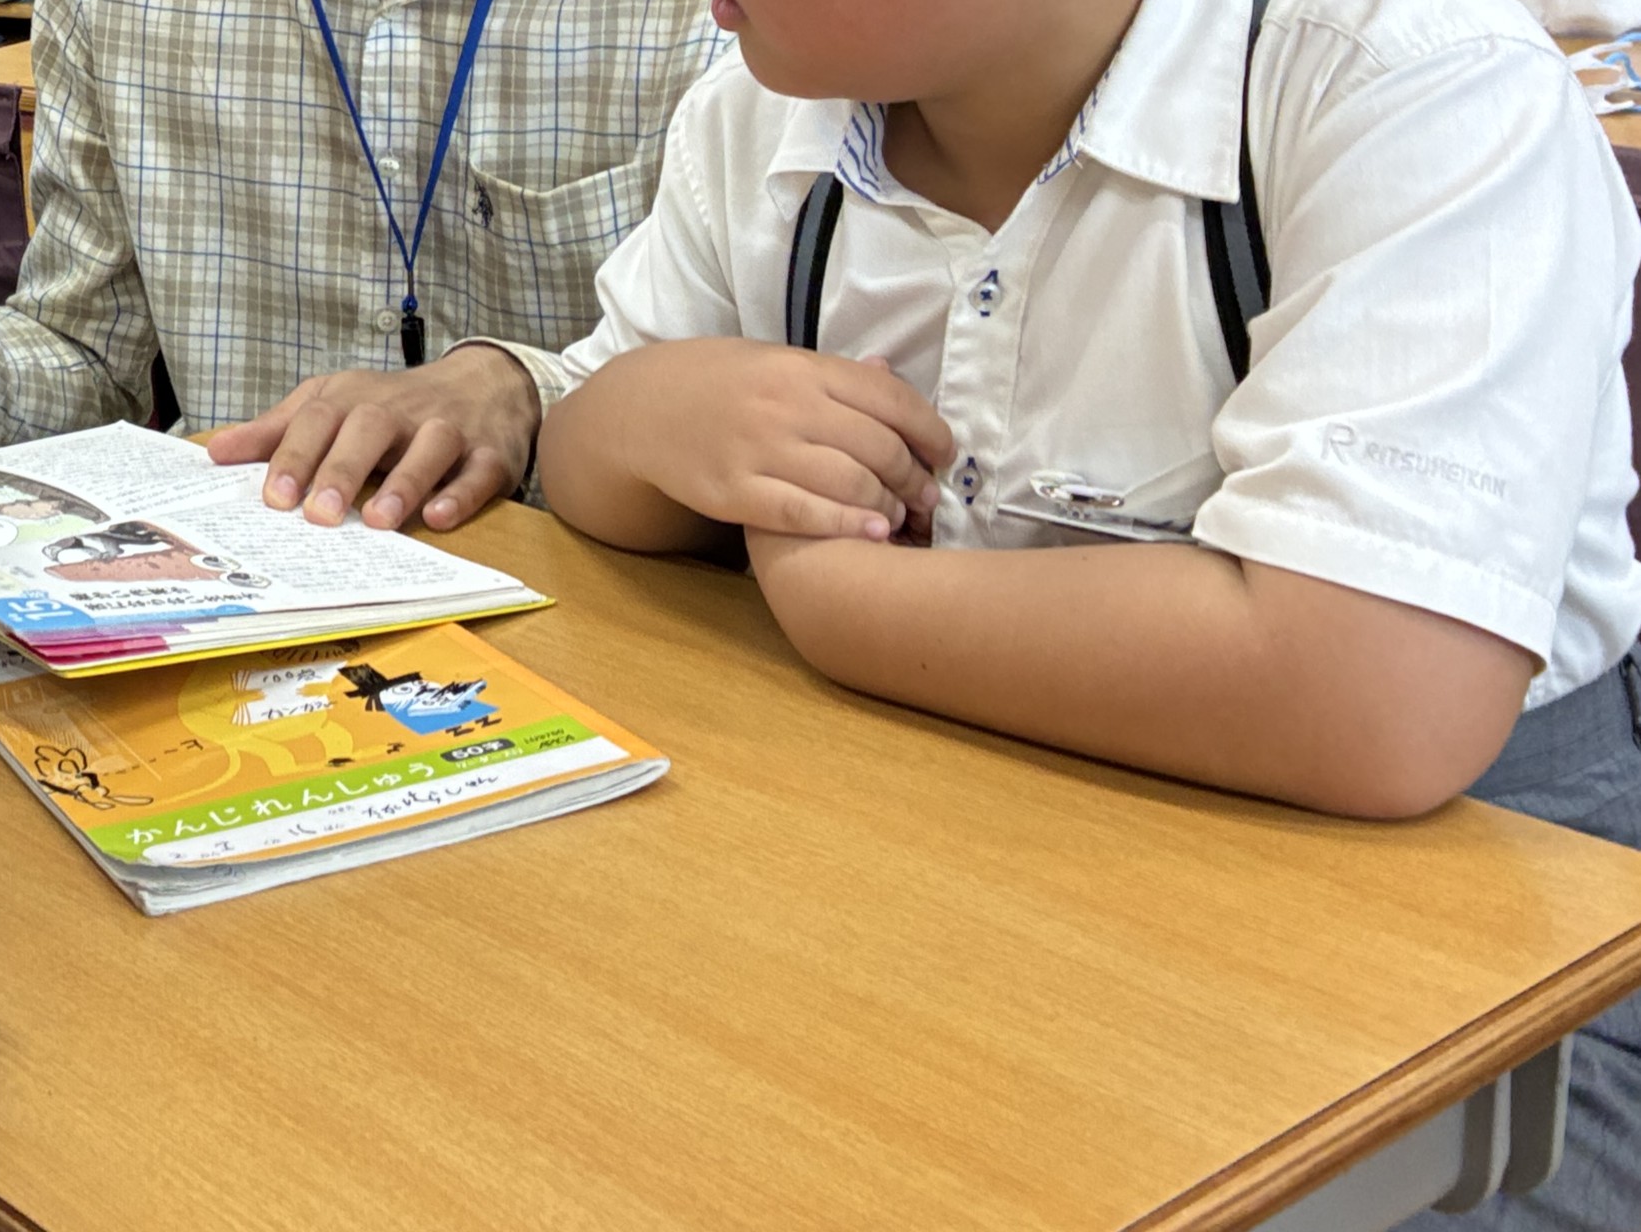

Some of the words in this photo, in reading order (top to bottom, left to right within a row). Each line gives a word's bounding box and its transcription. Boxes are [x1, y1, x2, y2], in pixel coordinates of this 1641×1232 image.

[1320, 422, 1357, 466] R
[125, 762, 435, 845] かんじれんしゅう
